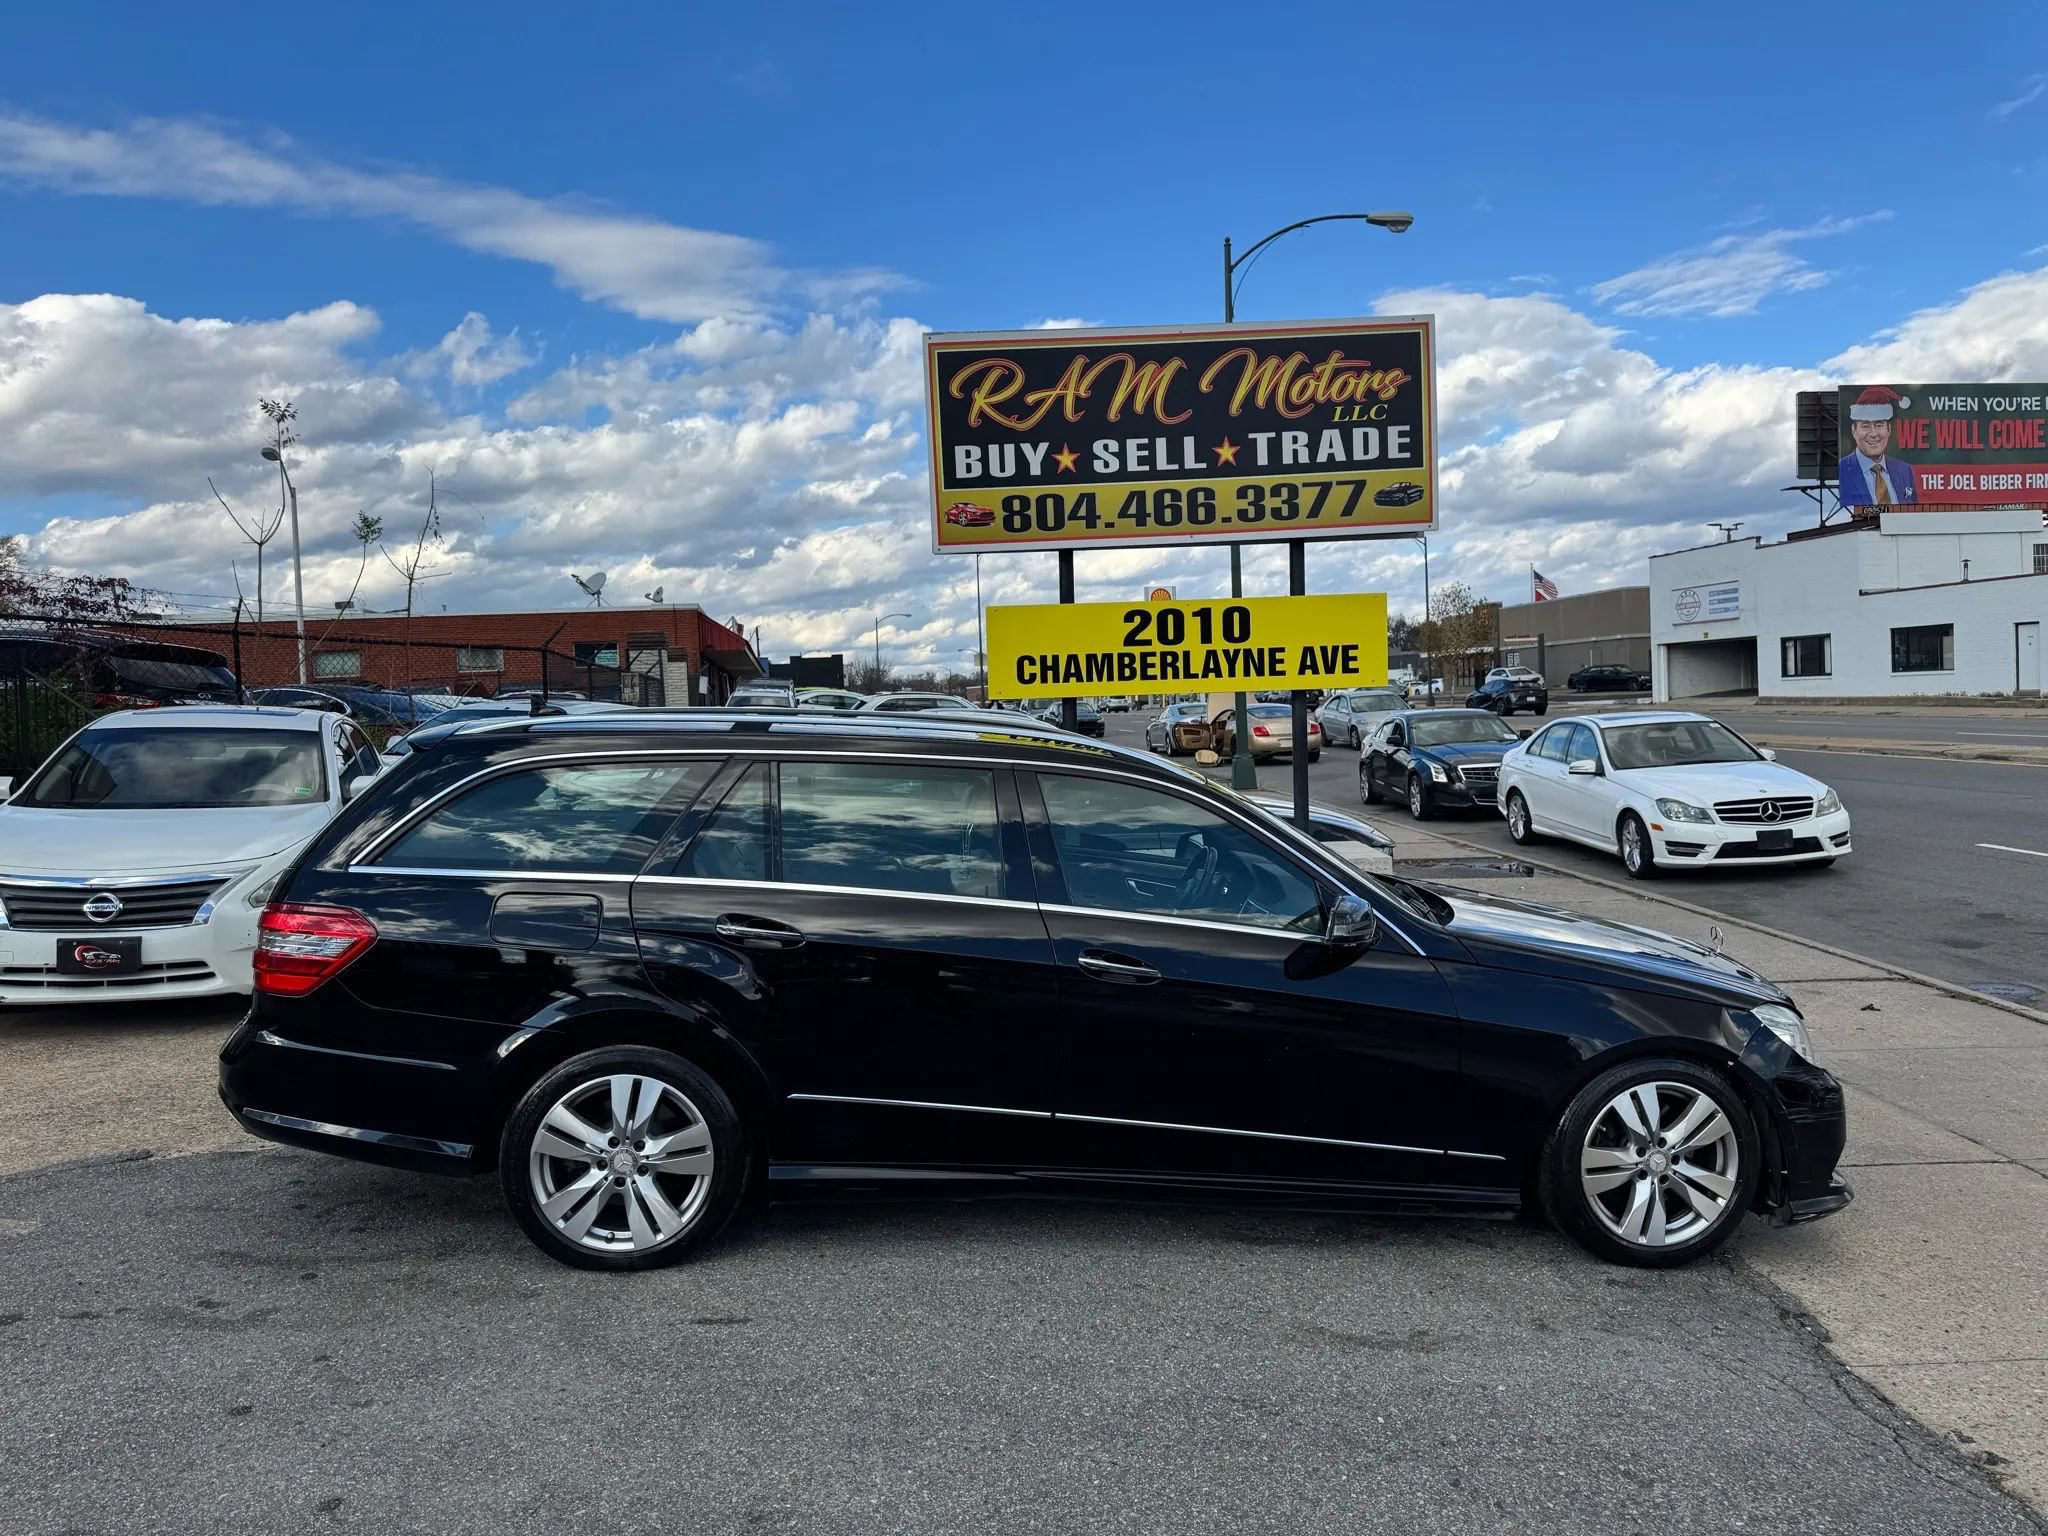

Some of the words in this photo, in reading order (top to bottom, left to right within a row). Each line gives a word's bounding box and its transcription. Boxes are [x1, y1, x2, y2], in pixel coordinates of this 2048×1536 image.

[949, 352, 1192, 431] RAM
[1199, 347, 1412, 419] Motors
[1929, 396, 1978, 411] WHEN
[1983, 396, 2040, 411] YOU'RE
[1331, 403, 1388, 423] LLC
[1896, 418, 1930, 449] WE
[1935, 418, 1984, 449] WILL
[1989, 418, 2045, 449] COME
[954, 441, 1050, 479] BUY
[1093, 435, 1207, 473] SELL
[1248, 425, 1411, 466] TRADE
[1921, 474, 1944, 490] THE
[1947, 474, 1977, 490] JOEL
[1980, 474, 2022, 490] BIEBER
[1000, 479, 1367, 534] 804.466.3377
[1123, 605, 1252, 648] 2010
[1016, 646, 1287, 685] CHAMBERLAYNE
[1298, 644, 1360, 677] AVE
